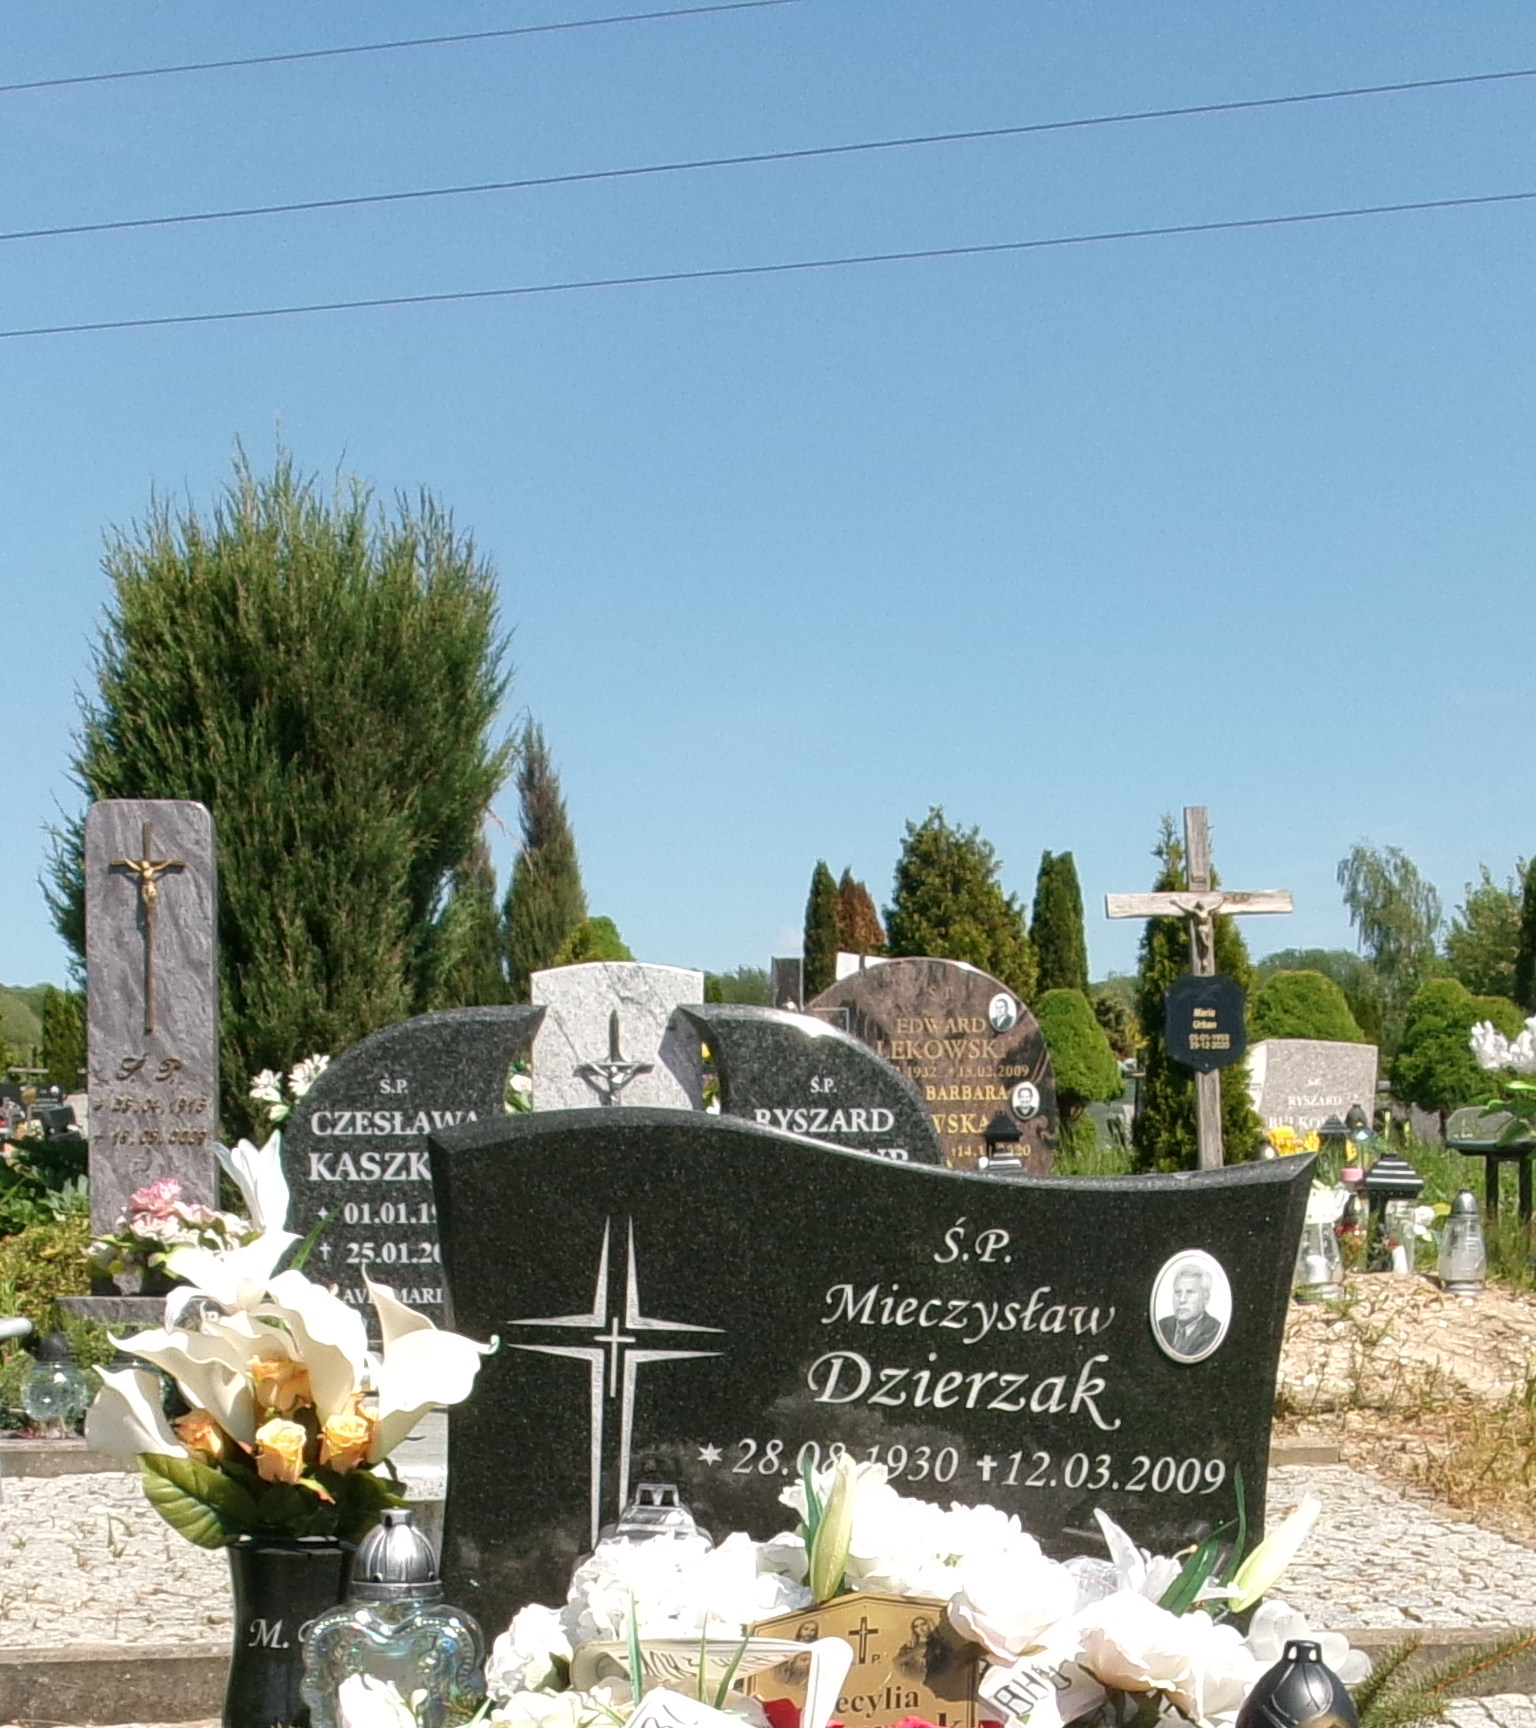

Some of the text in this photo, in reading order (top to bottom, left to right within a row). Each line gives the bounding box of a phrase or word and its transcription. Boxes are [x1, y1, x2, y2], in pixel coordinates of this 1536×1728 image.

[896, 1017, 987, 1034] EDWARD
[809, 1074, 838, 1093] Ś.P.
[925, 1085, 1009, 1101] BARBARA
[753, 1108, 895, 1133] RYSZARD
[933, 1217, 1012, 1264] Ś.P.
[820, 1282, 1115, 1345] Mieczysław
[807, 1350, 1121, 1431] Dzierzak
[731, 1437, 1227, 1495] 28.081930 12.03.2009
